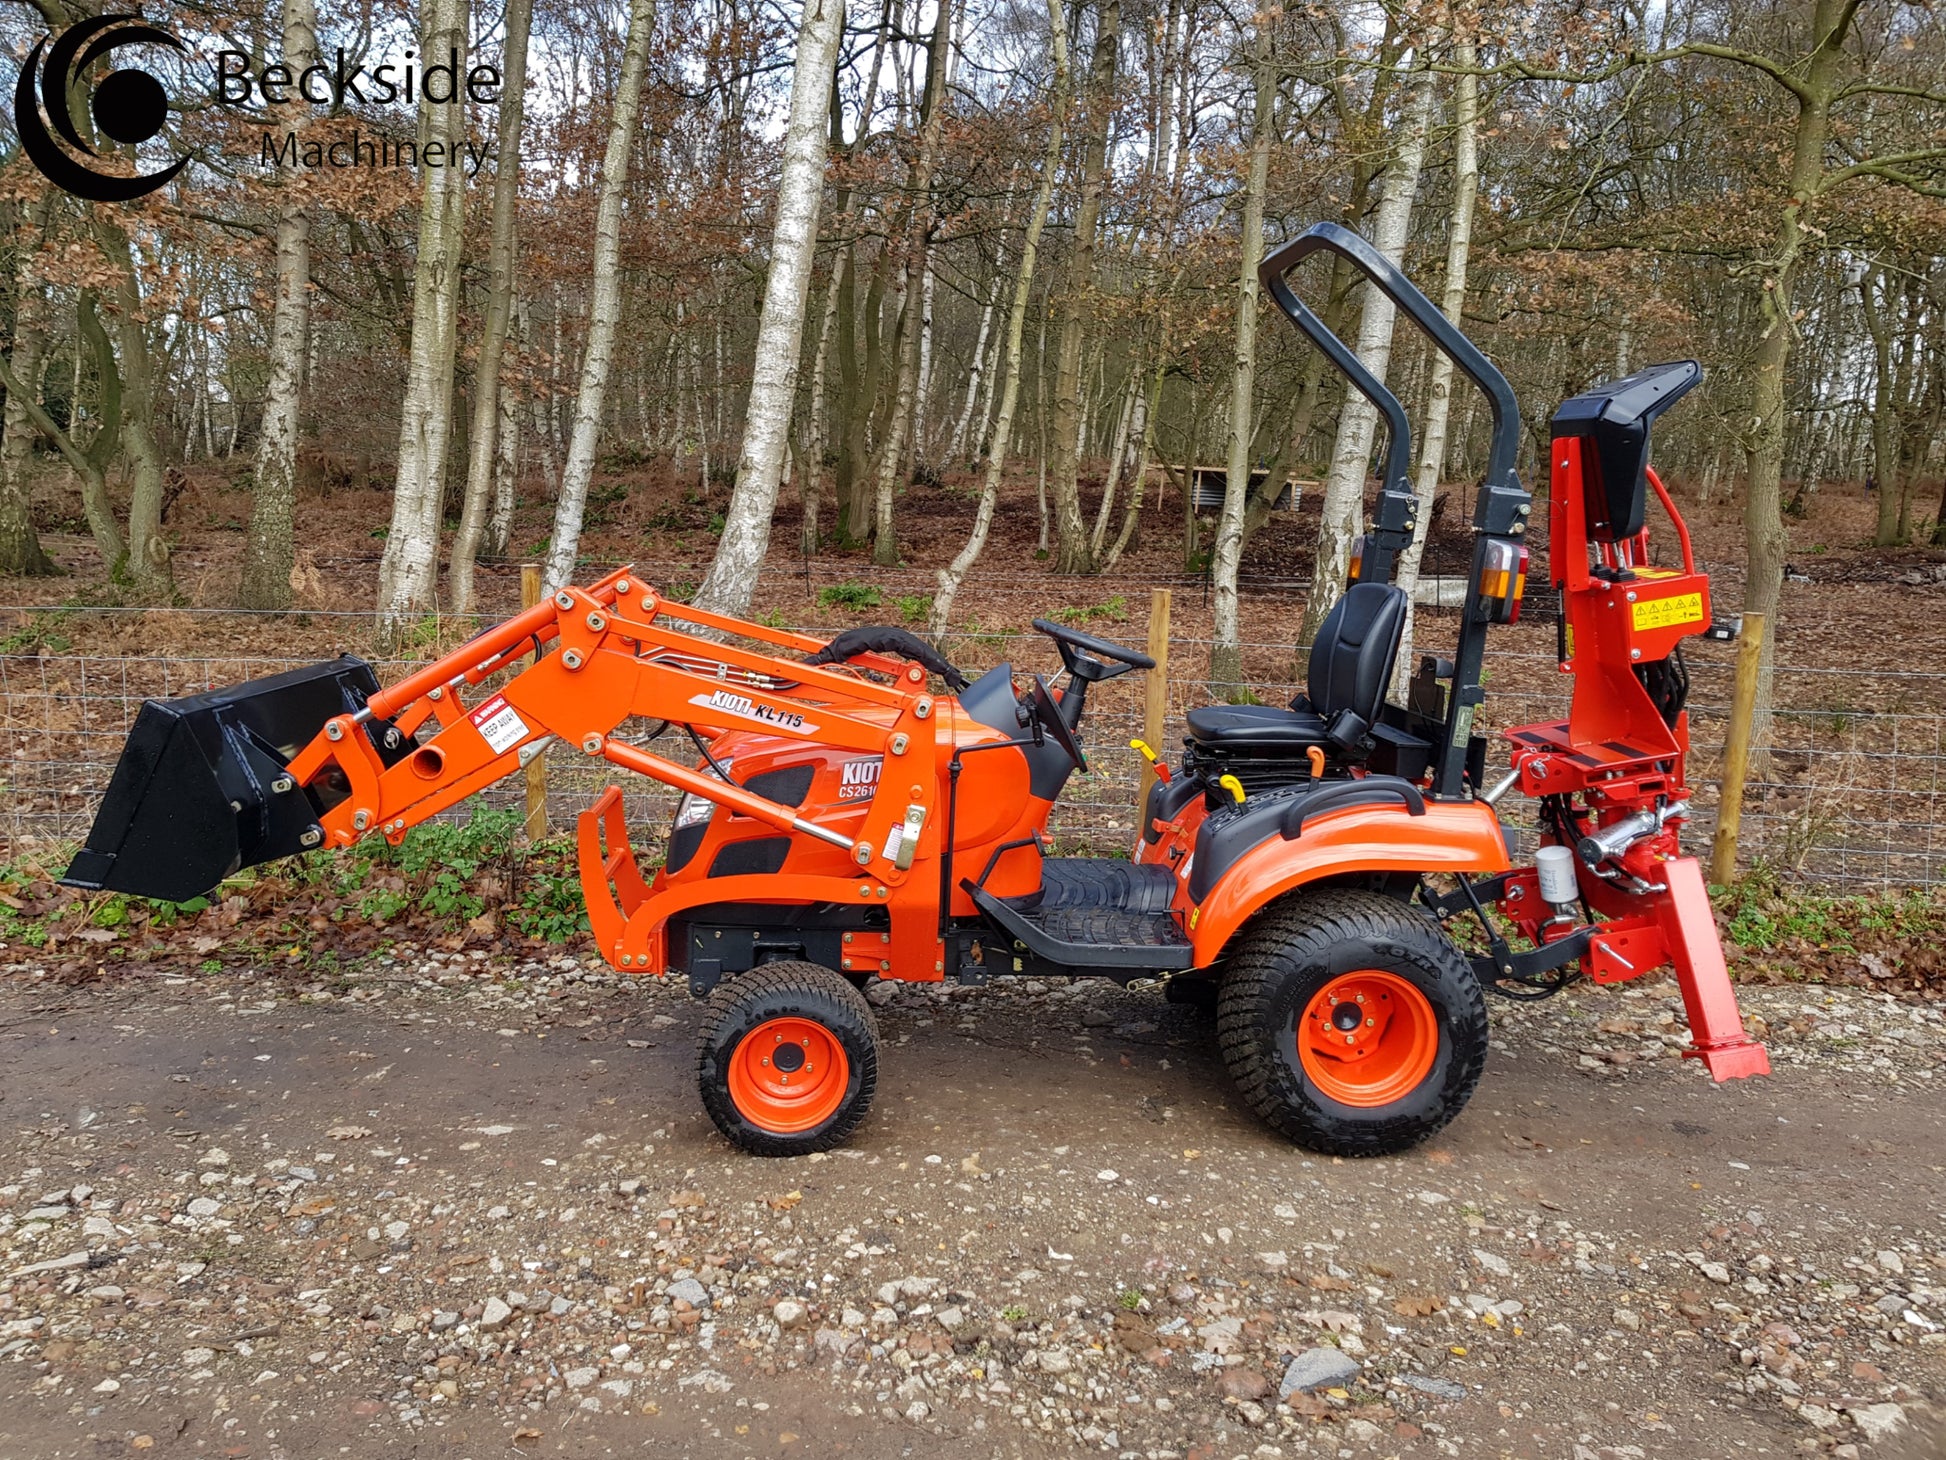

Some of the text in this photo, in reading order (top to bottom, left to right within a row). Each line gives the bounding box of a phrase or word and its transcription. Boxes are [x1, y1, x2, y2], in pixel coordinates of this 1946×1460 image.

[709, 689, 804, 728] KIOTI KL 115
[482, 722, 498, 738] KEEP
[497, 710, 515, 728] AWAY
[842, 761, 883, 785] KIOT
